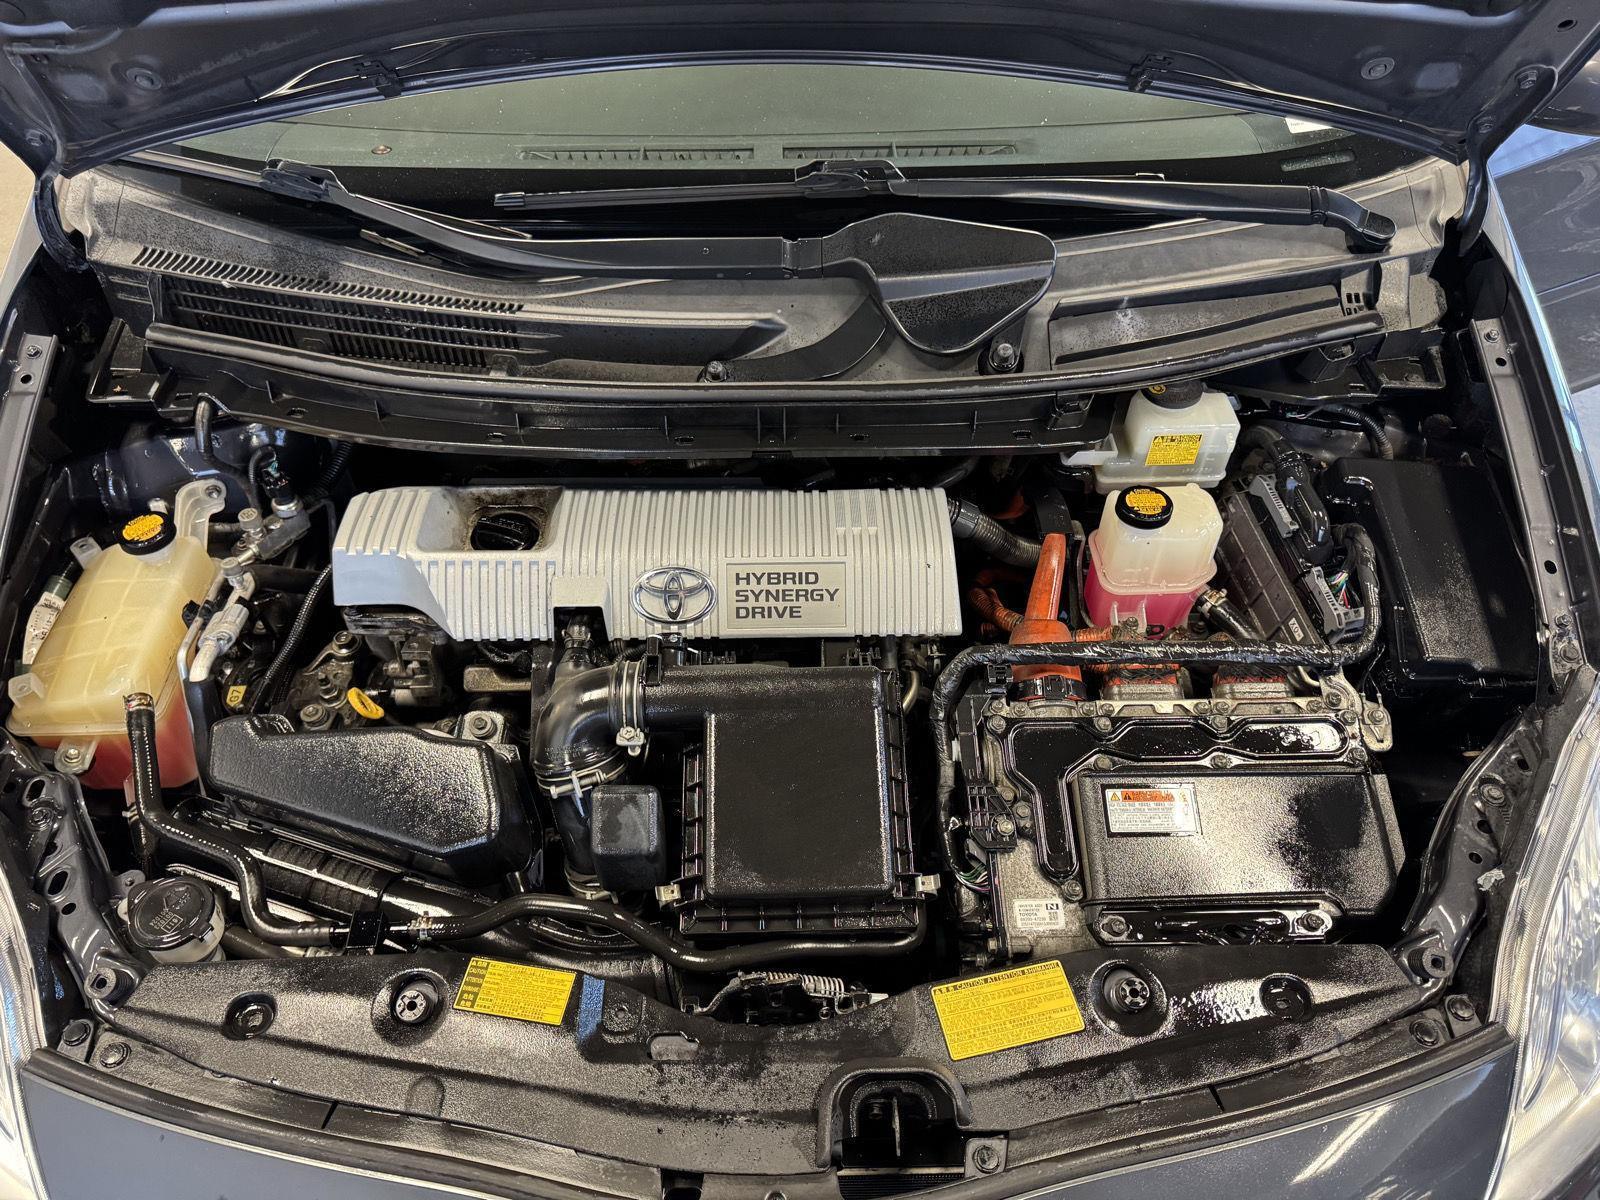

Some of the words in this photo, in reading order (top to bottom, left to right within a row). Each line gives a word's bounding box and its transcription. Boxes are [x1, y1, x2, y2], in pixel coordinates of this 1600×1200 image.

[735, 571, 819, 586] HYBRID
[735, 588, 840, 602] SYNERGY
[735, 606, 802, 619] DRIVE
[229, 689, 242, 703] G7
[469, 967, 487, 975] CAUTION
[956, 978, 985, 990] CAUTION
[987, 970, 1023, 983] ATTENTION
